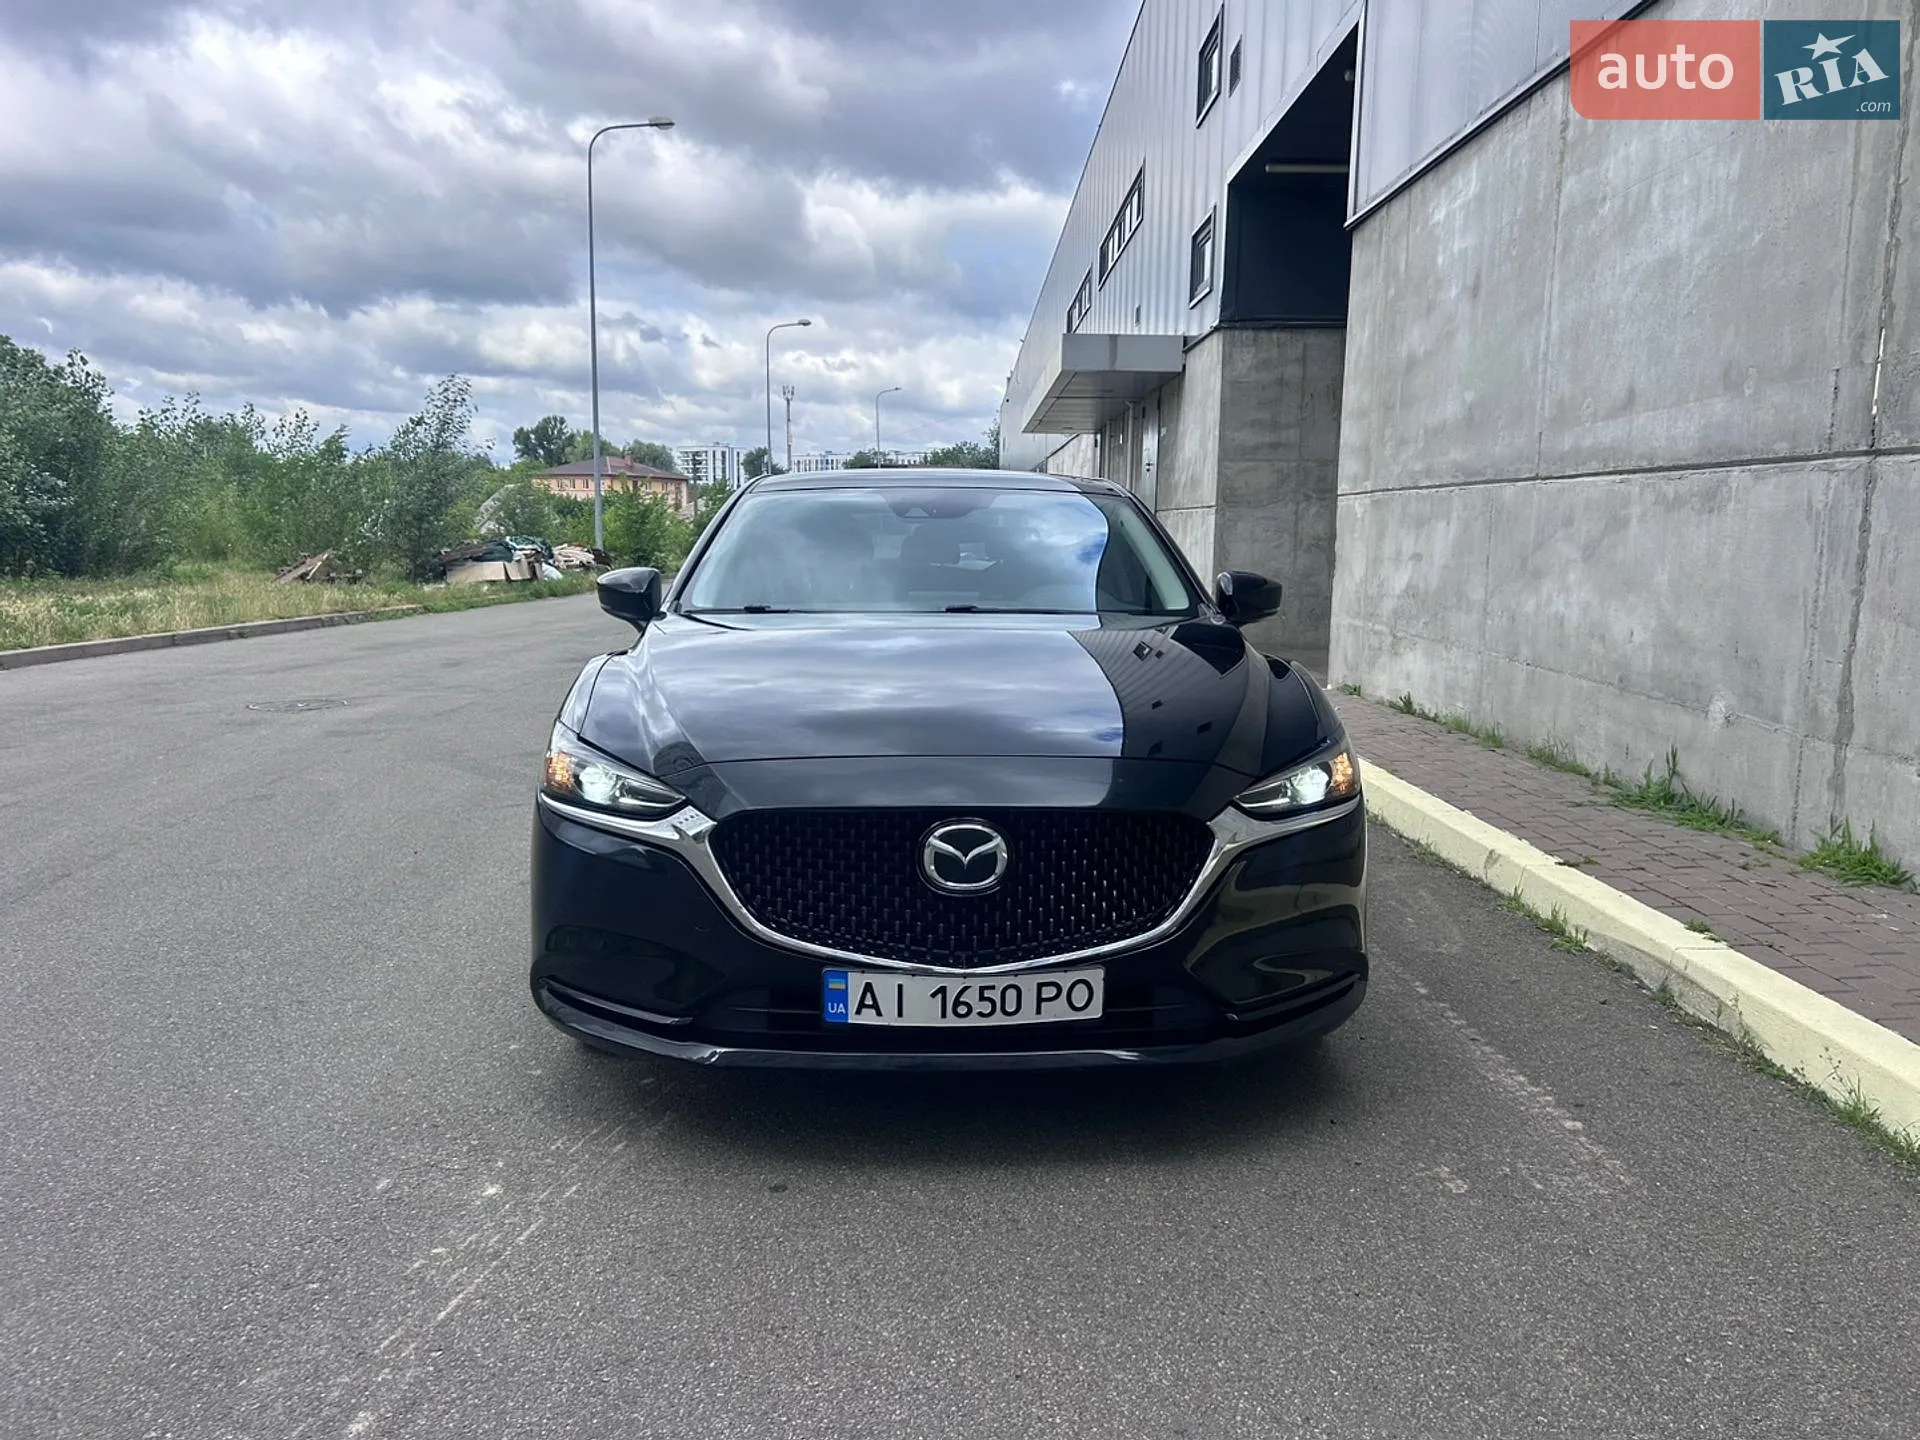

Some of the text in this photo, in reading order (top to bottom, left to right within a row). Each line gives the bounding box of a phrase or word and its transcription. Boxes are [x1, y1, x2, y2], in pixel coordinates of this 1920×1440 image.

[827, 1003, 847, 1014] UA
[854, 978, 1095, 1019] AI 1650 PO
